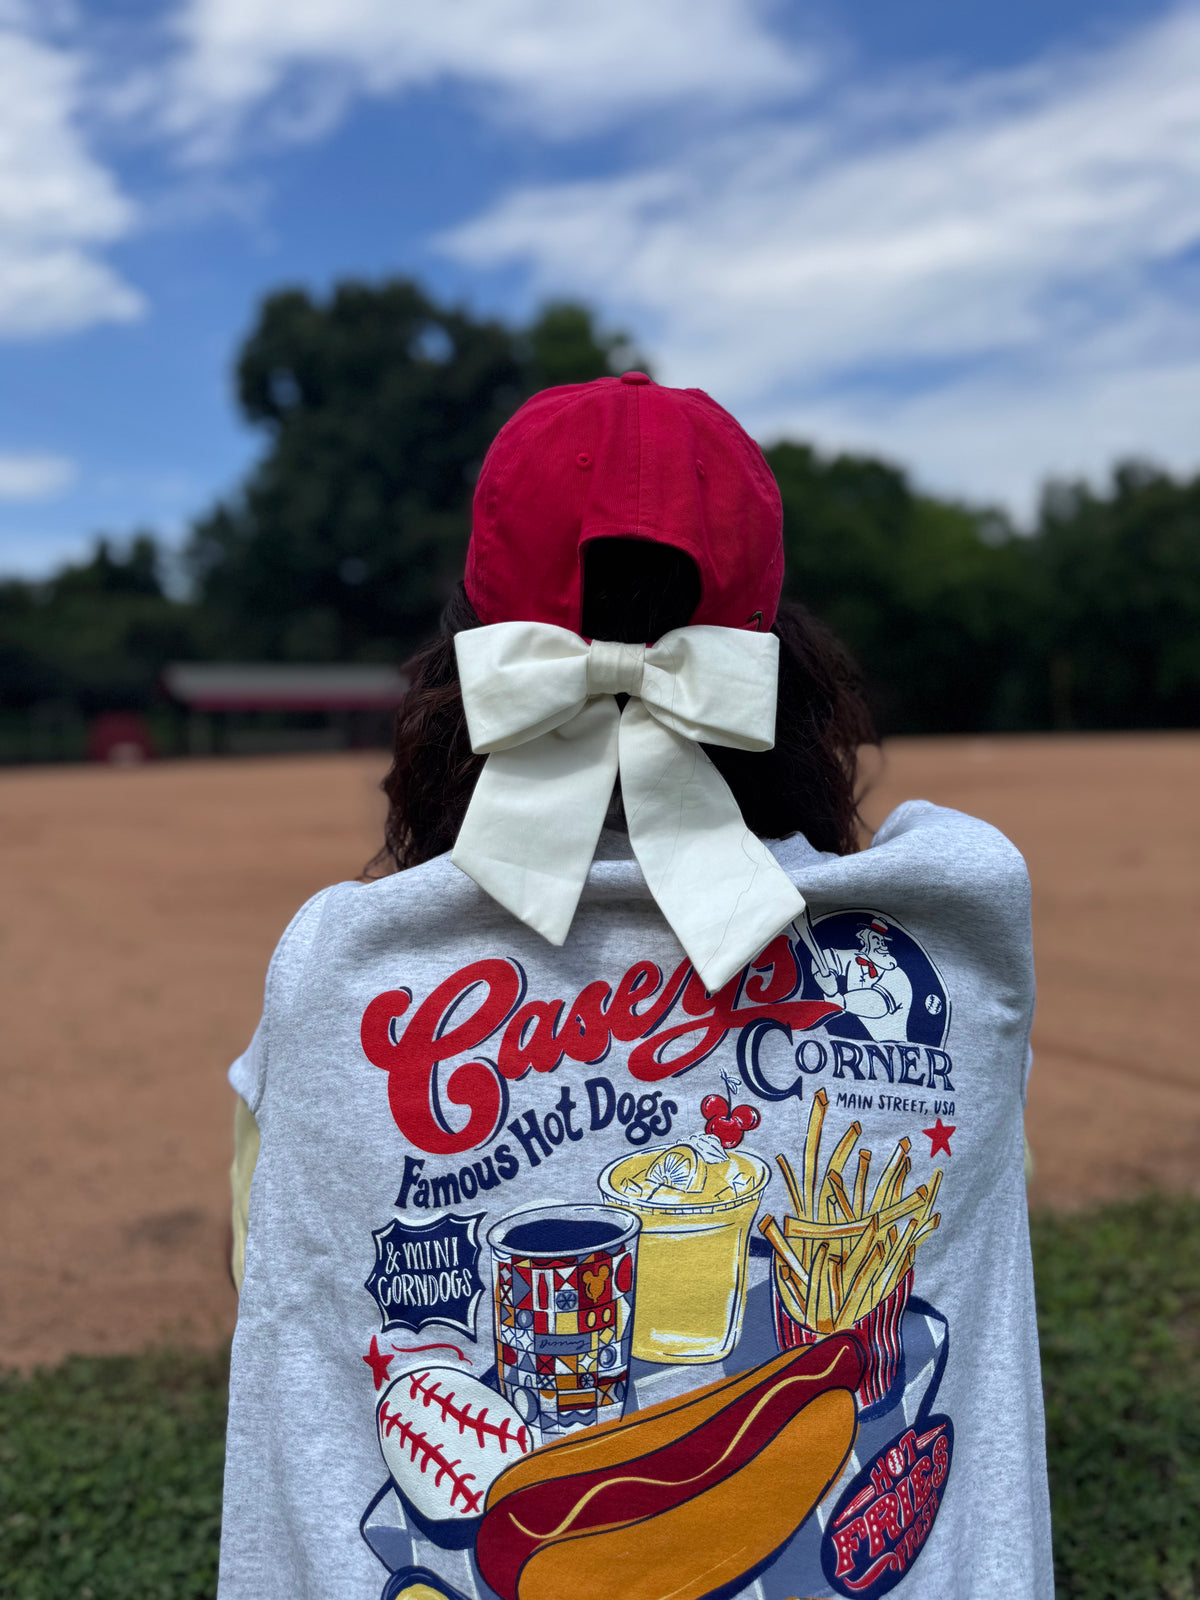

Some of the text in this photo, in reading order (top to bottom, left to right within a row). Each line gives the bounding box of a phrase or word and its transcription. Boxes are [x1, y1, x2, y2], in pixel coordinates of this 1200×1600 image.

[360, 934, 843, 1154] Caseys
[736, 1017, 955, 1102] CORNER
[394, 1076, 678, 1209] Famous Hot Dogs
[836, 1092, 955, 1116] MAIN STREET, USA
[377, 1268, 473, 1307] CORNDOGS
[386, 1237, 458, 1274] & MINI
[870, 1429, 917, 1496] HOT
[832, 1435, 948, 1578] FRIES
[895, 1490, 938, 1571] FRESH
